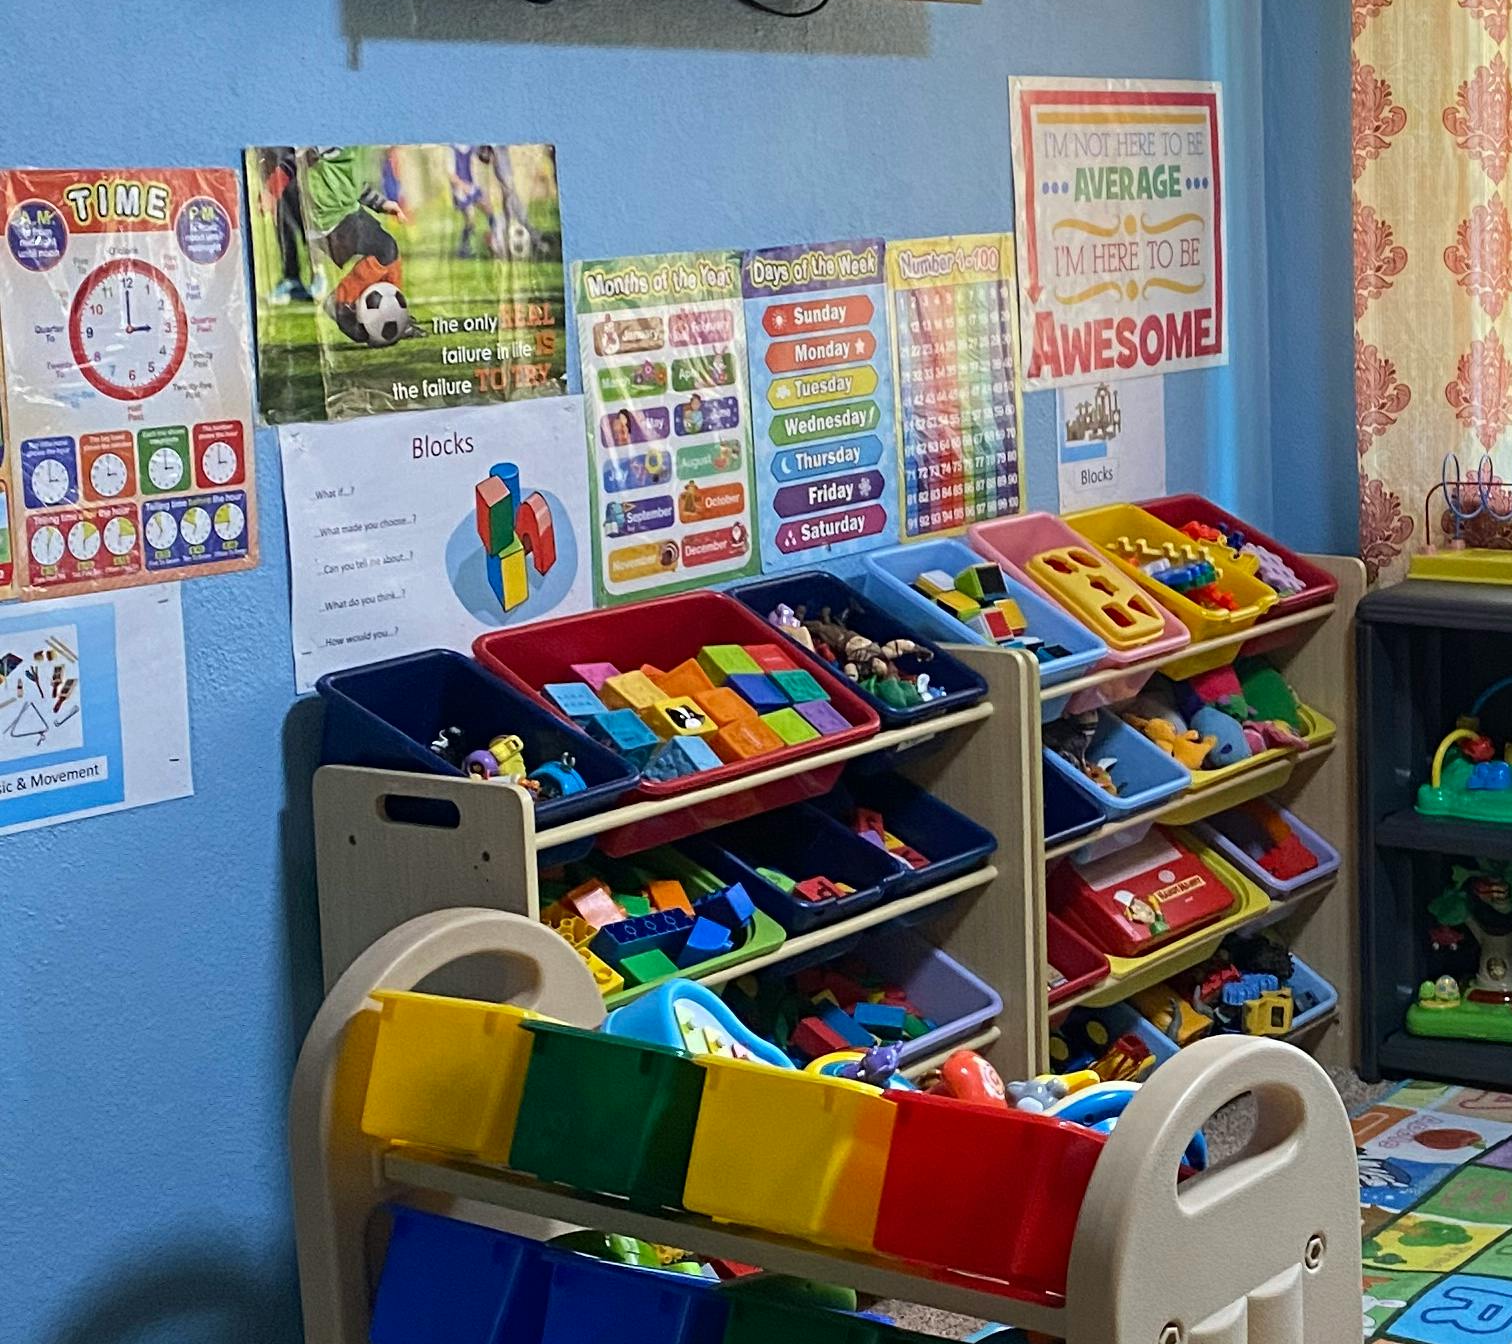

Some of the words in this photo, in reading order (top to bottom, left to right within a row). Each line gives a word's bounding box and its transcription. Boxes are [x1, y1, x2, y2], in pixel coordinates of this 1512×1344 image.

[1074, 132, 1111, 158] NOT
[1116, 131, 1156, 157] HERE
[1162, 131, 1183, 156] TO
[1186, 131, 1205, 156] BE
[1074, 164, 1182, 203] AVERAGE
[66, 182, 170, 223] TIME
[900, 250, 954, 279] Number
[1054, 245, 1085, 277] I'M
[1092, 241, 1140, 274] HERE
[1146, 239, 1174, 269] TO
[1179, 237, 1201, 268] BE
[753, 259, 790, 286] Days
[794, 258, 808, 280] of
[812, 253, 836, 276] the
[838, 251, 876, 276] Week
[121, 277, 133, 289] 12
[145, 285, 150, 295] 1
[587, 272, 649, 299] Months
[653, 269, 669, 292] of
[672, 267, 698, 292] the
[699, 262, 735, 289] Year
[102, 287, 113, 298] 11
[89, 304, 104, 315] 10
[157, 299, 165, 310] 2
[793, 304, 847, 325] Sunday
[85, 327, 94, 338] 9
[164, 321, 172, 333] 3
[431, 316, 458, 334] The
[463, 313, 497, 333] only
[159, 345, 167, 356] 4
[442, 346, 492, 365] failure
[497, 342, 509, 360] in
[511, 340, 533, 359] life
[535, 330, 556, 356] IS
[795, 340, 850, 362] Monday
[1027, 307, 1214, 379] AWESOME
[94, 351, 102, 361] 8
[109, 366, 116, 377] 7
[129, 369, 136, 381] 6
[147, 361, 156, 373] 5
[392, 382, 419, 401] the
[422, 378, 472, 398] failure
[474, 367, 505, 393] TO
[794, 375, 853, 398] Tuesday
[784, 407, 867, 437] Wednesday
[412, 431, 475, 459] Blocks
[796, 446, 861, 470] Thursday
[1080, 465, 1114, 486] Blocks
[705, 493, 741, 509] October
[808, 482, 854, 505] Friday
[627, 507, 673, 526] September
[364, 522, 379, 534] you
[801, 514, 866, 541] Saturday
[685, 539, 728, 557] December
[340, 562, 355, 575] you
[355, 558, 369, 570] tell
[349, 596, 360, 607] do
[361, 596, 377, 608] you
[346, 631, 372, 643] would
[16, 777, 28, 791] &
[30, 764, 100, 788] Movement
